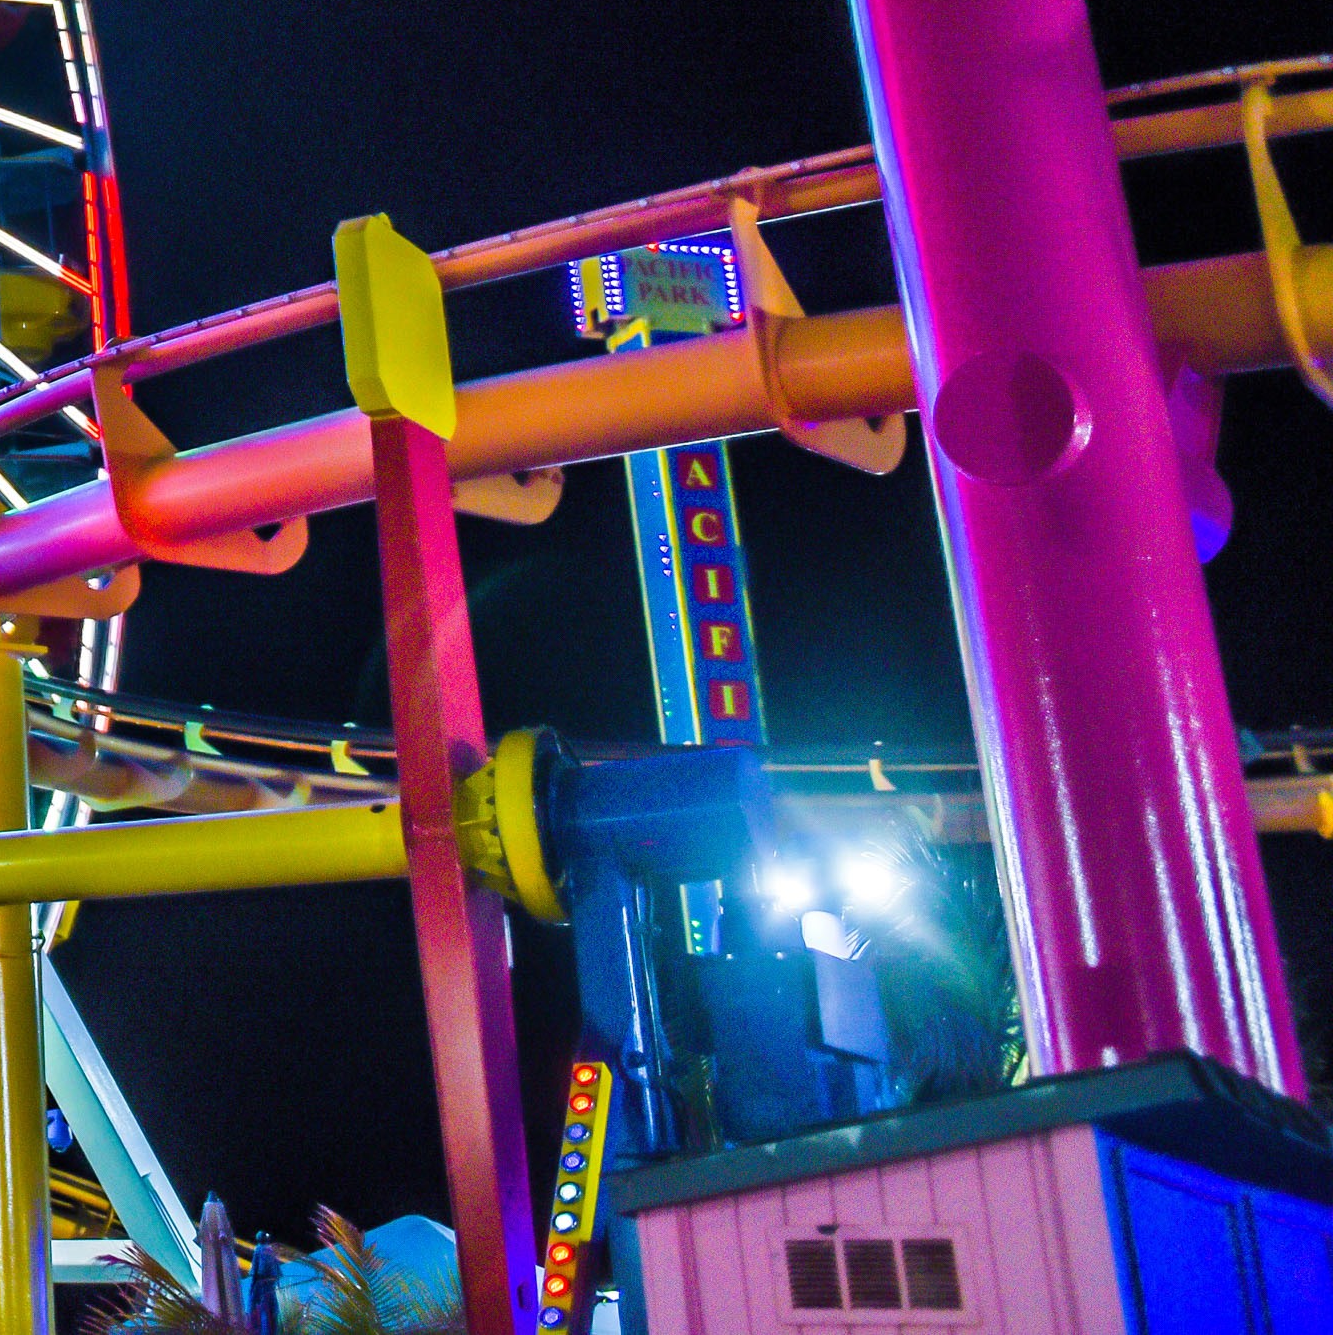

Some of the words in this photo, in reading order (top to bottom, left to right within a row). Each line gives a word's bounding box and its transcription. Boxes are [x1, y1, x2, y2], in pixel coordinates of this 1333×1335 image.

[622, 255, 717, 283] PACIFIC
[637, 281, 711, 306] PARK
[685, 457, 735, 716] ACIFI
